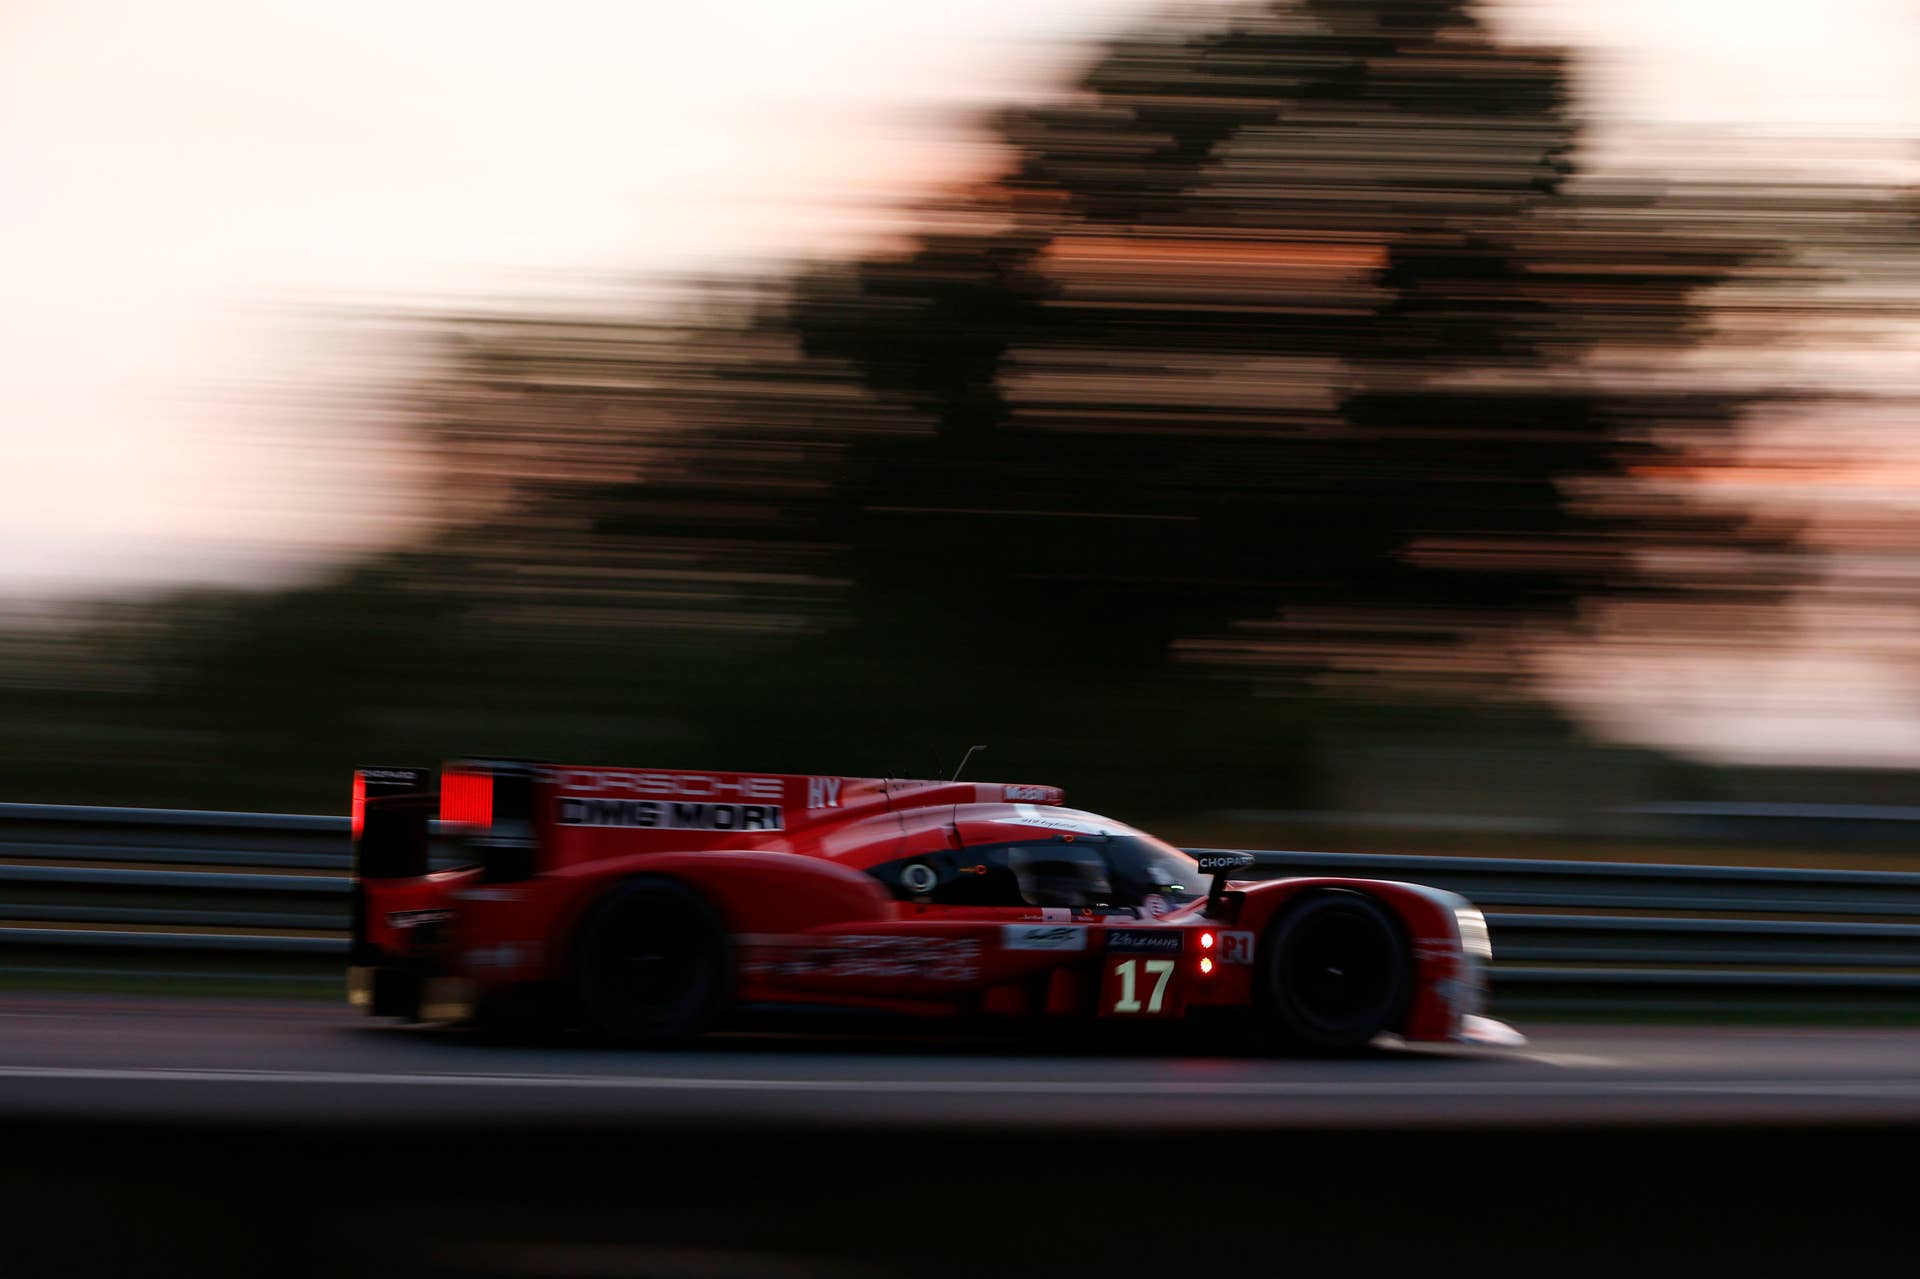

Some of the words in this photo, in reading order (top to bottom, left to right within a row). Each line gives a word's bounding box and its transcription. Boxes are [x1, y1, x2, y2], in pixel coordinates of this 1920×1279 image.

[807, 777, 841, 809] HY
[1222, 936, 1249, 960] P1
[1112, 959, 1176, 1014] 17
